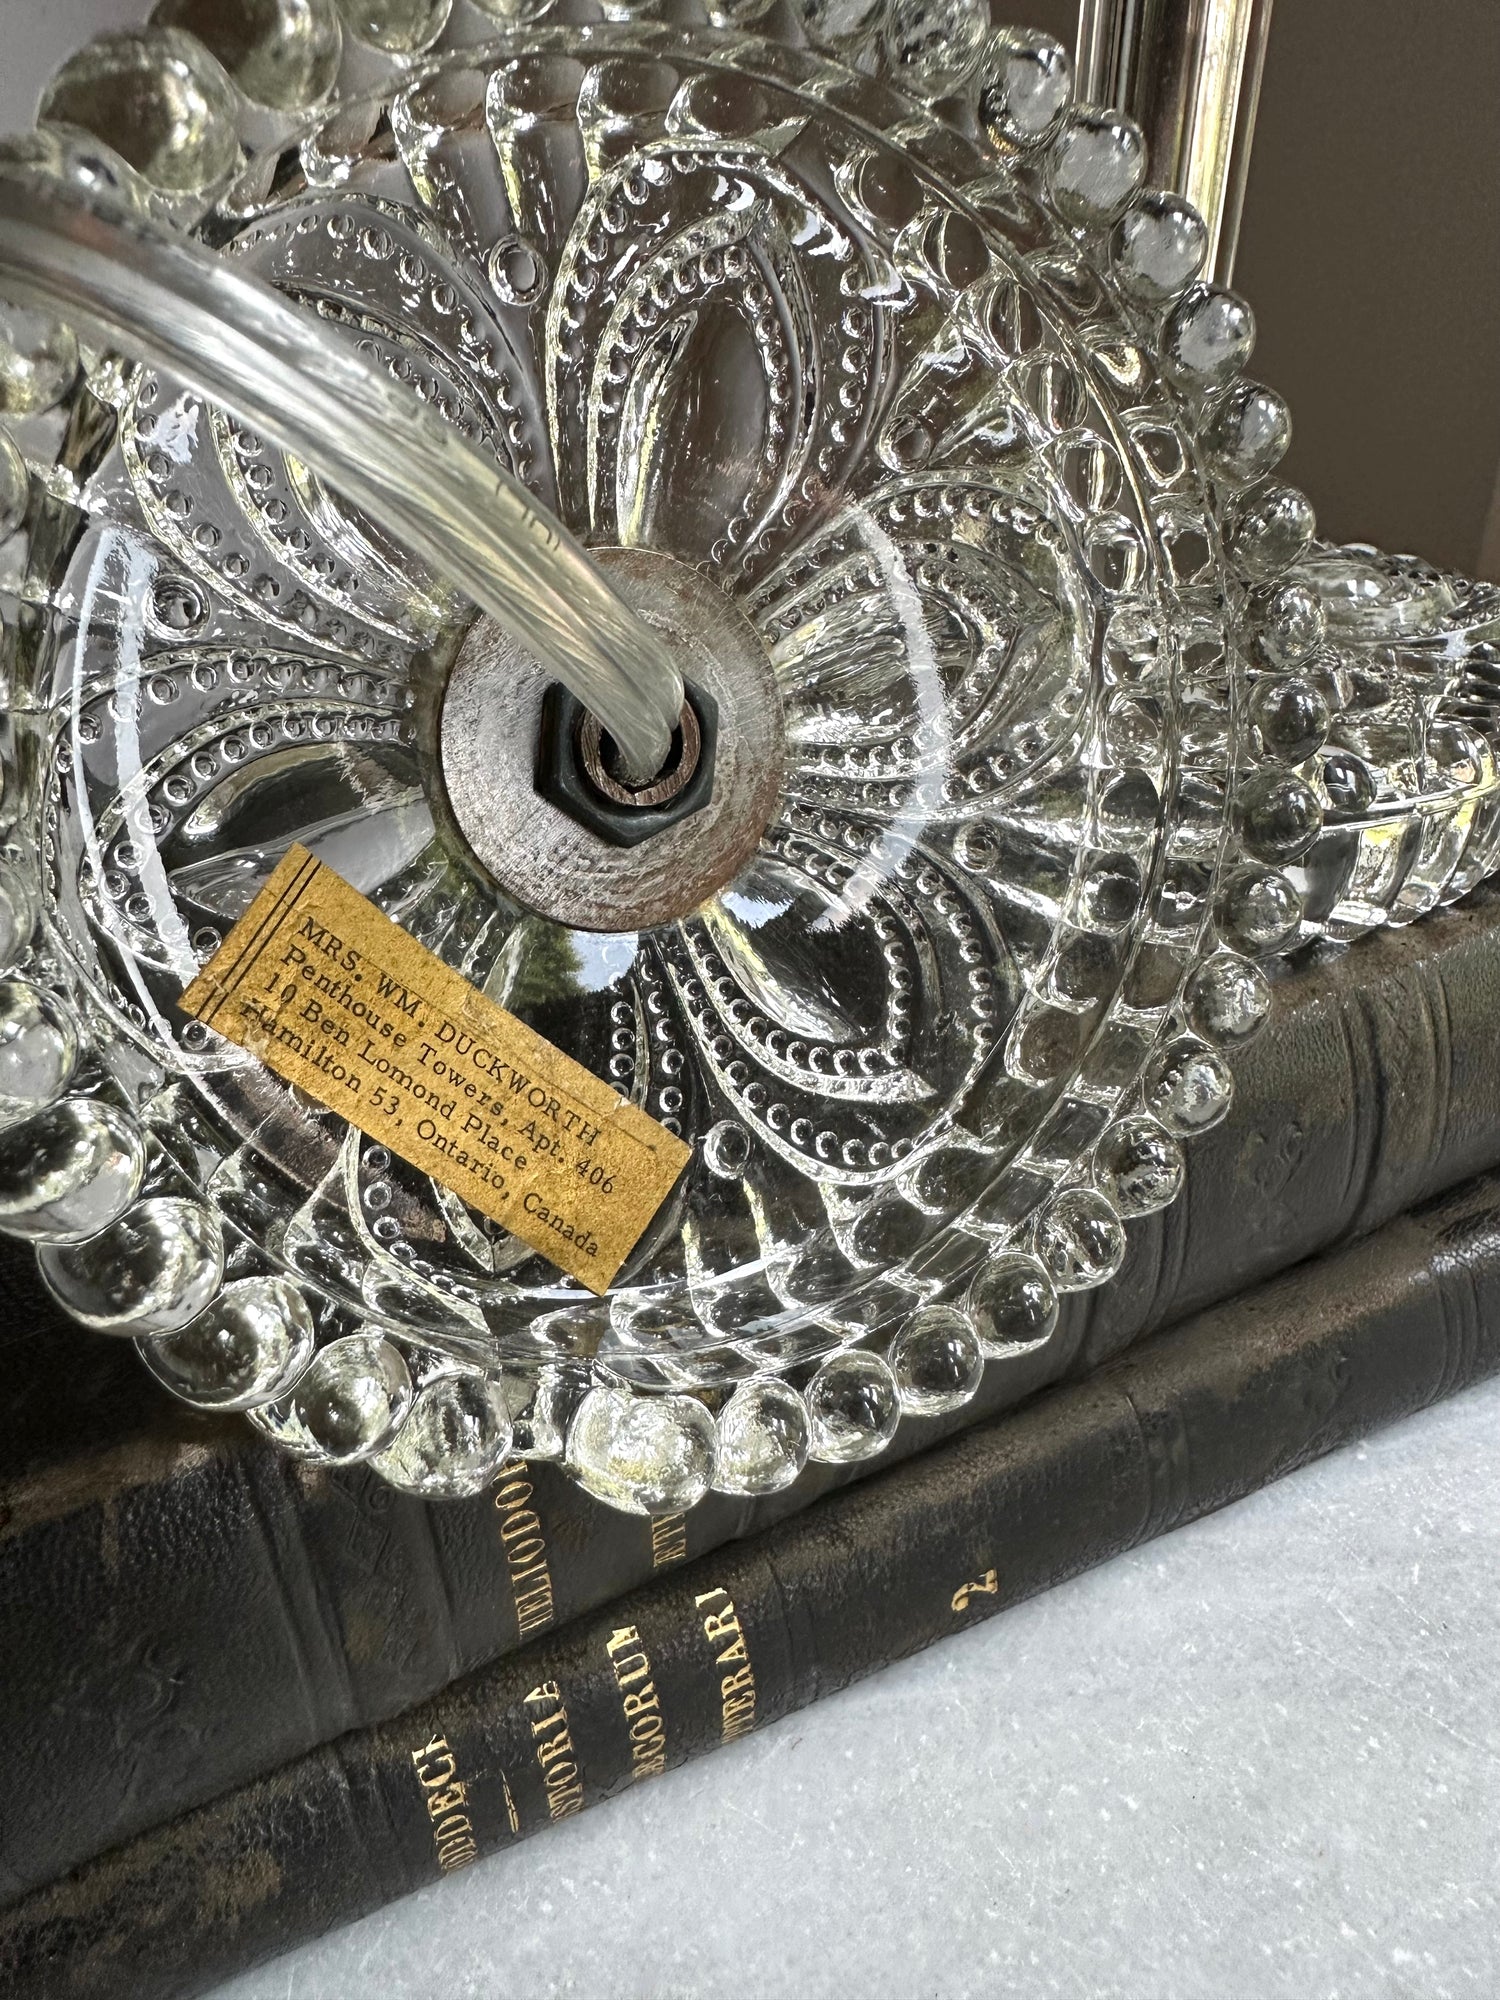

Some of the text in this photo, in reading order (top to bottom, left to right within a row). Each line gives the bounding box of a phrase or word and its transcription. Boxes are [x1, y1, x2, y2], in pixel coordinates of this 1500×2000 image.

[239, 997, 599, 1258] Hamilton 53, Ontario, Canada
[264, 973, 528, 1171] 10 Ben Lomond Place
[280, 944, 615, 1195] Penthouse Towers, Apt. 406
[299, 916, 602, 1147] MRS. WM. DUCKWORTH
[951, 1568, 998, 1612] 2
